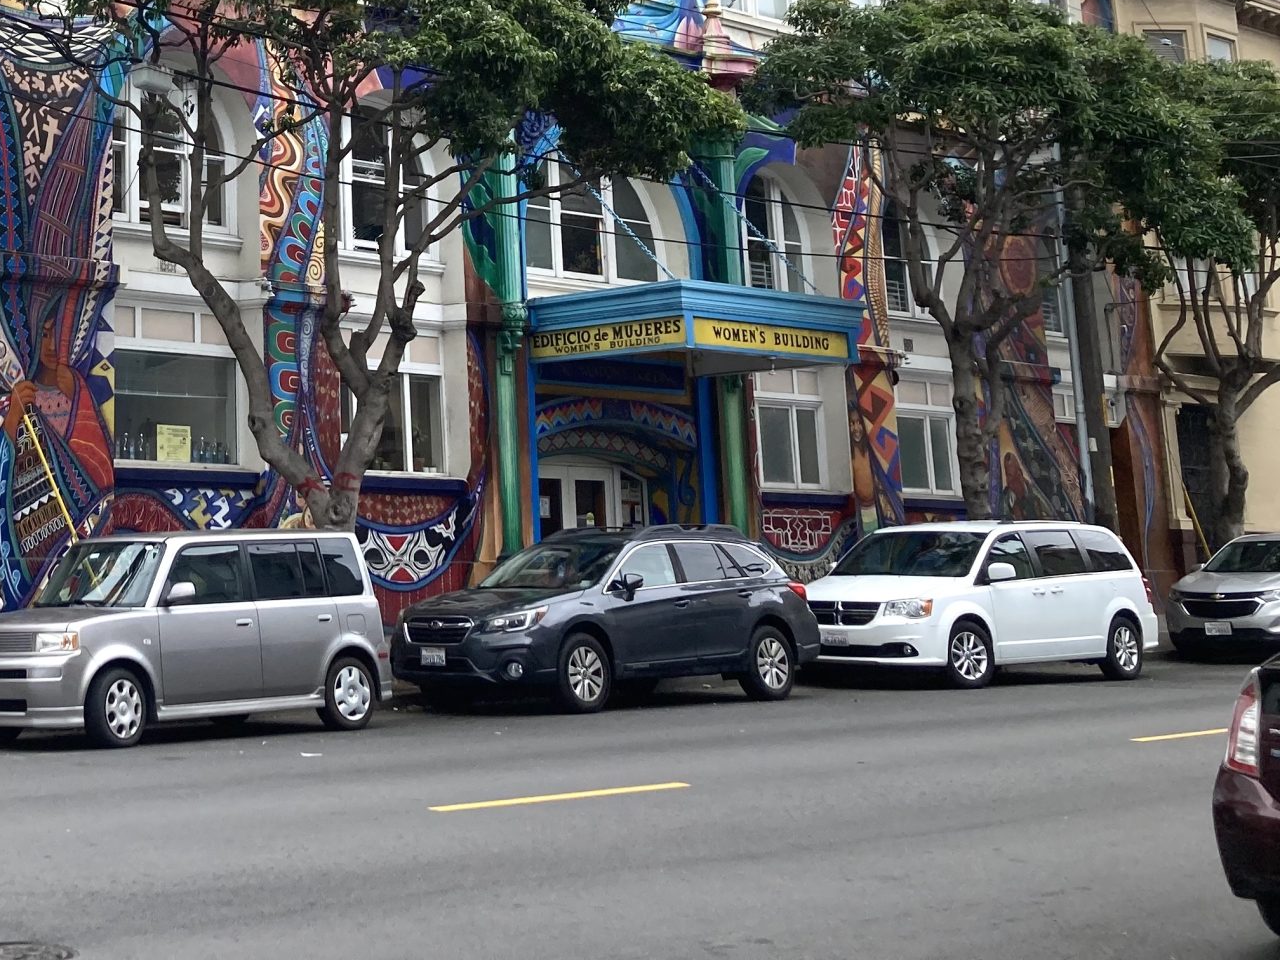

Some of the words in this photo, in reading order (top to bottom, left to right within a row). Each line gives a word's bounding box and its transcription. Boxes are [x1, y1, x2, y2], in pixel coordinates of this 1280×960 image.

[532, 329, 591, 349] EDIFICIO
[593, 328, 609, 341] de
[612, 319, 681, 340] MUJERES
[554, 342, 600, 354] WOMEN'S
[609, 335, 661, 349] BUILDING
[712, 326, 766, 344] WOMEN'S
[773, 331, 830, 351] BUILDING
